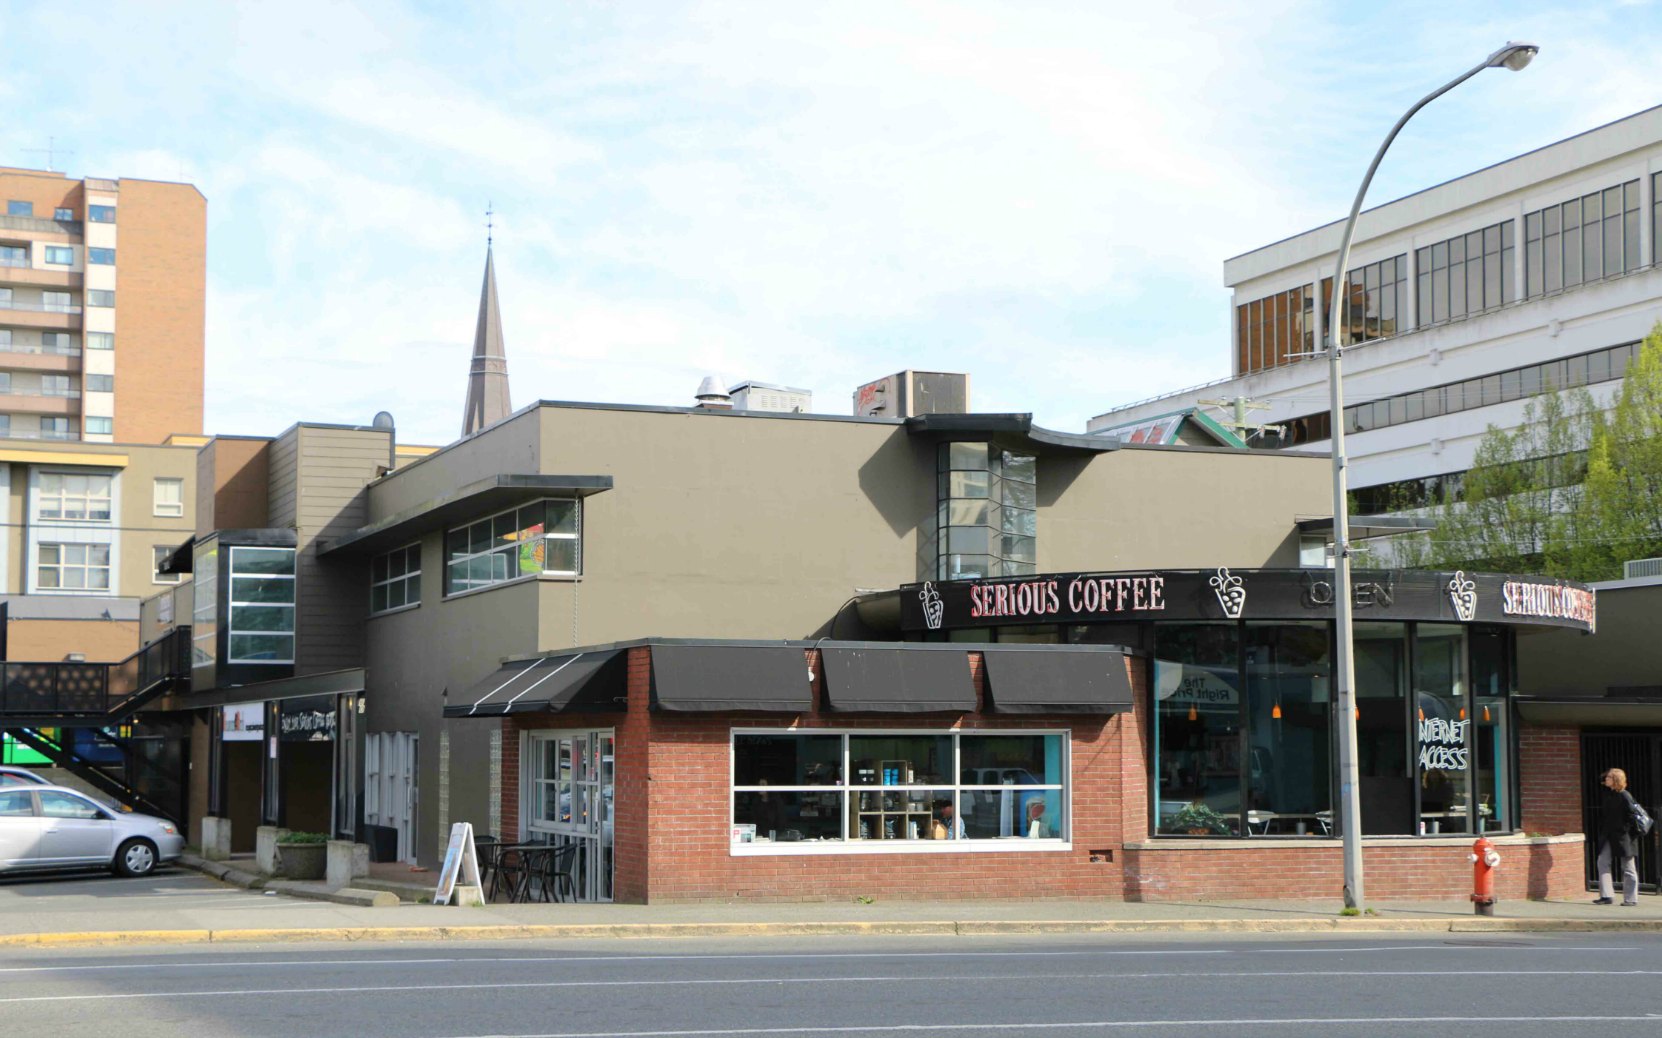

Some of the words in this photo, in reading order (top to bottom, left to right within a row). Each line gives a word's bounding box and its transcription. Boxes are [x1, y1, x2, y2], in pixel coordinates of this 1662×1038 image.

[970, 580, 1060, 617] SERIOUS
[1068, 577, 1166, 613] COFFEE
[1310, 581, 1394, 604] OEN
[1503, 581, 1562, 617] SERIOUS
[1419, 718, 1470, 744] NTERNET
[1419, 745, 1468, 770] ACCESS
